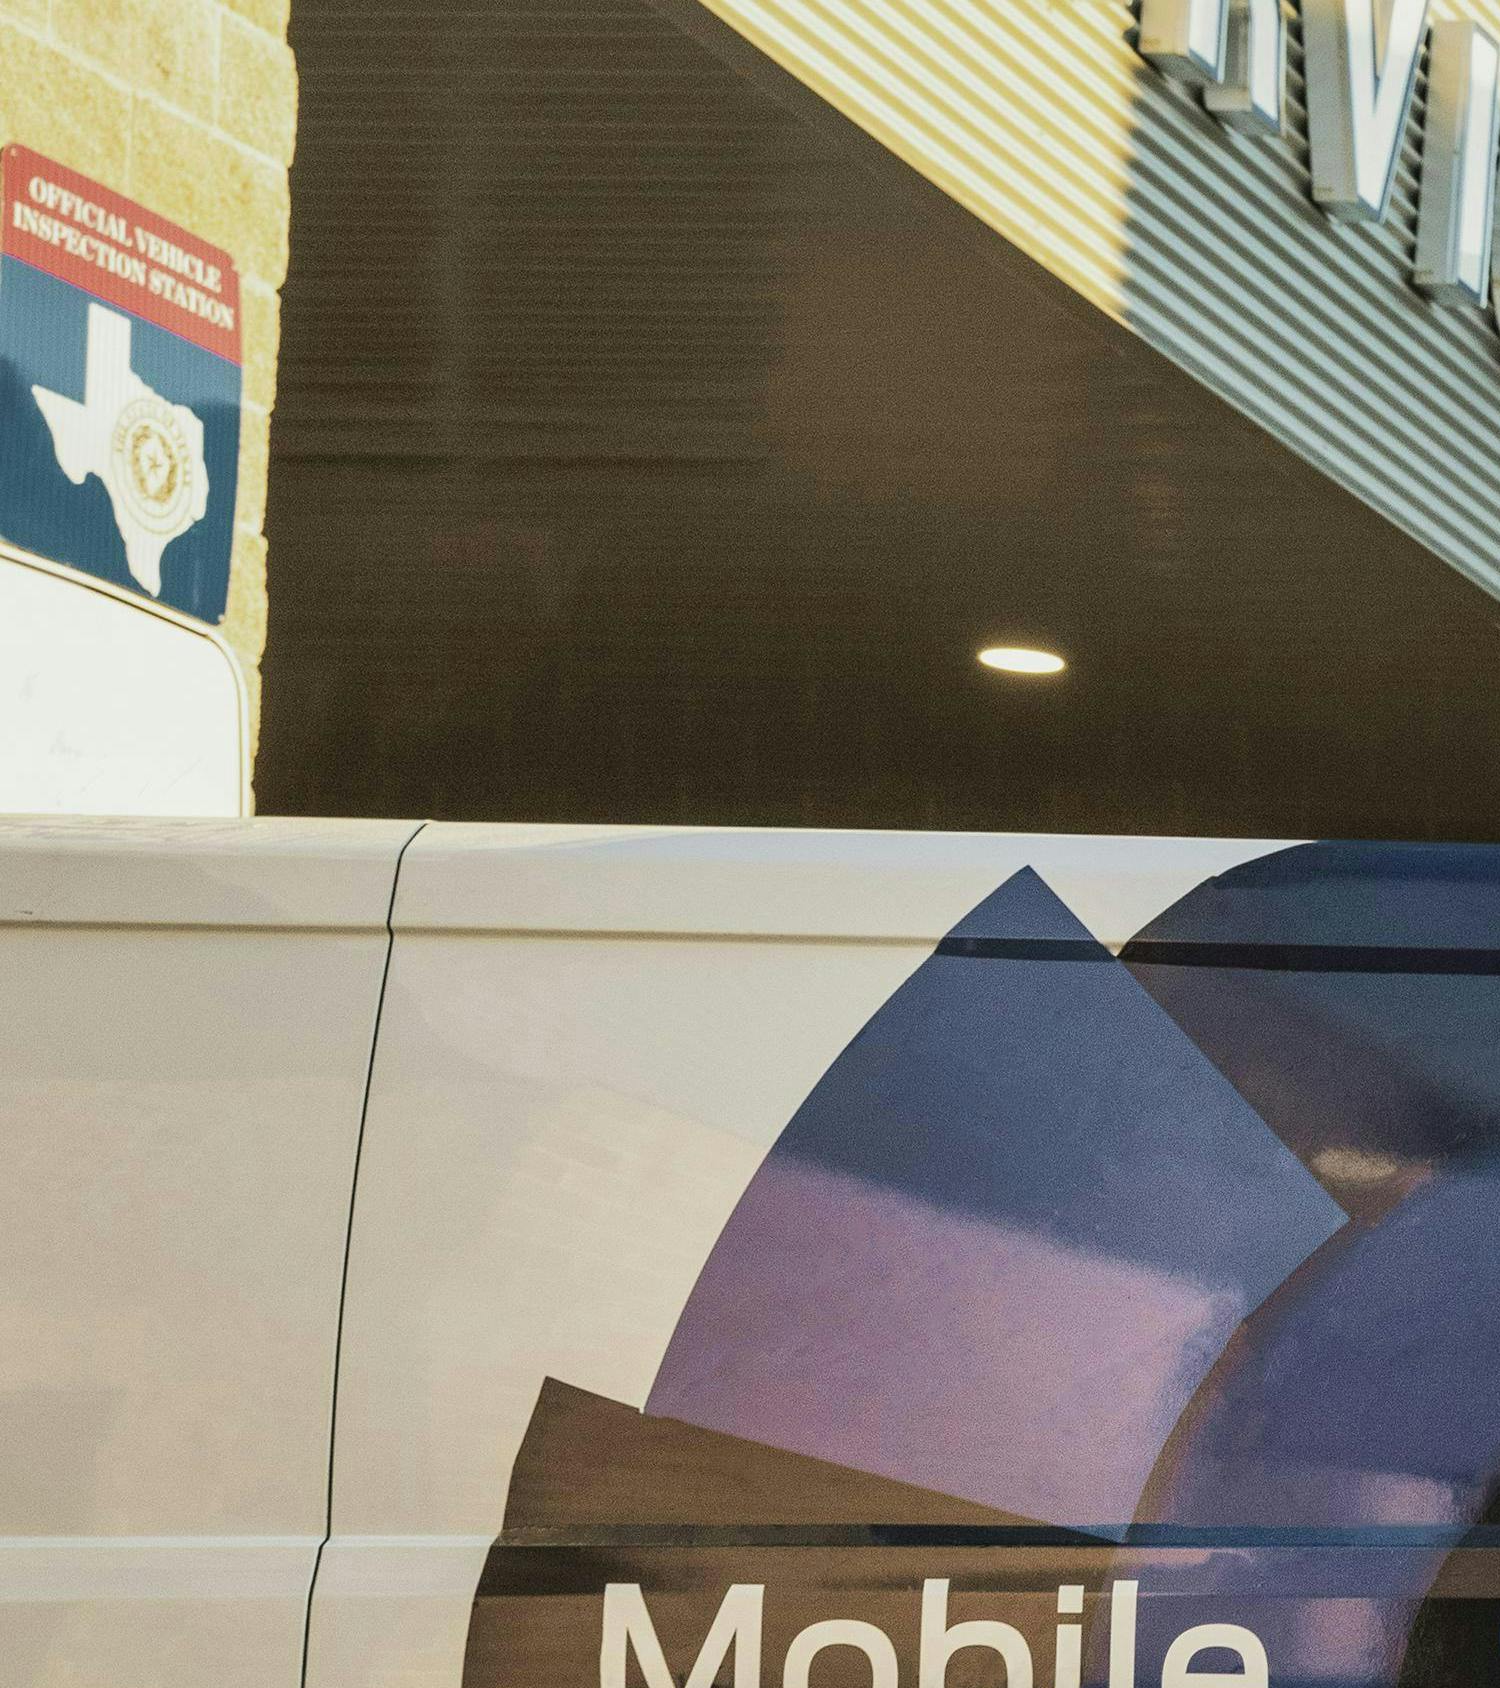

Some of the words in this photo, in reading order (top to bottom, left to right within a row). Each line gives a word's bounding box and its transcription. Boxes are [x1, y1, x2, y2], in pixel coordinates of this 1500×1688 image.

[12, 199, 147, 287] INSPECTION
[148, 267, 235, 332] STATION
[28, 175, 133, 248] OFFICIAL
[134, 226, 223, 294] VEHICLE
